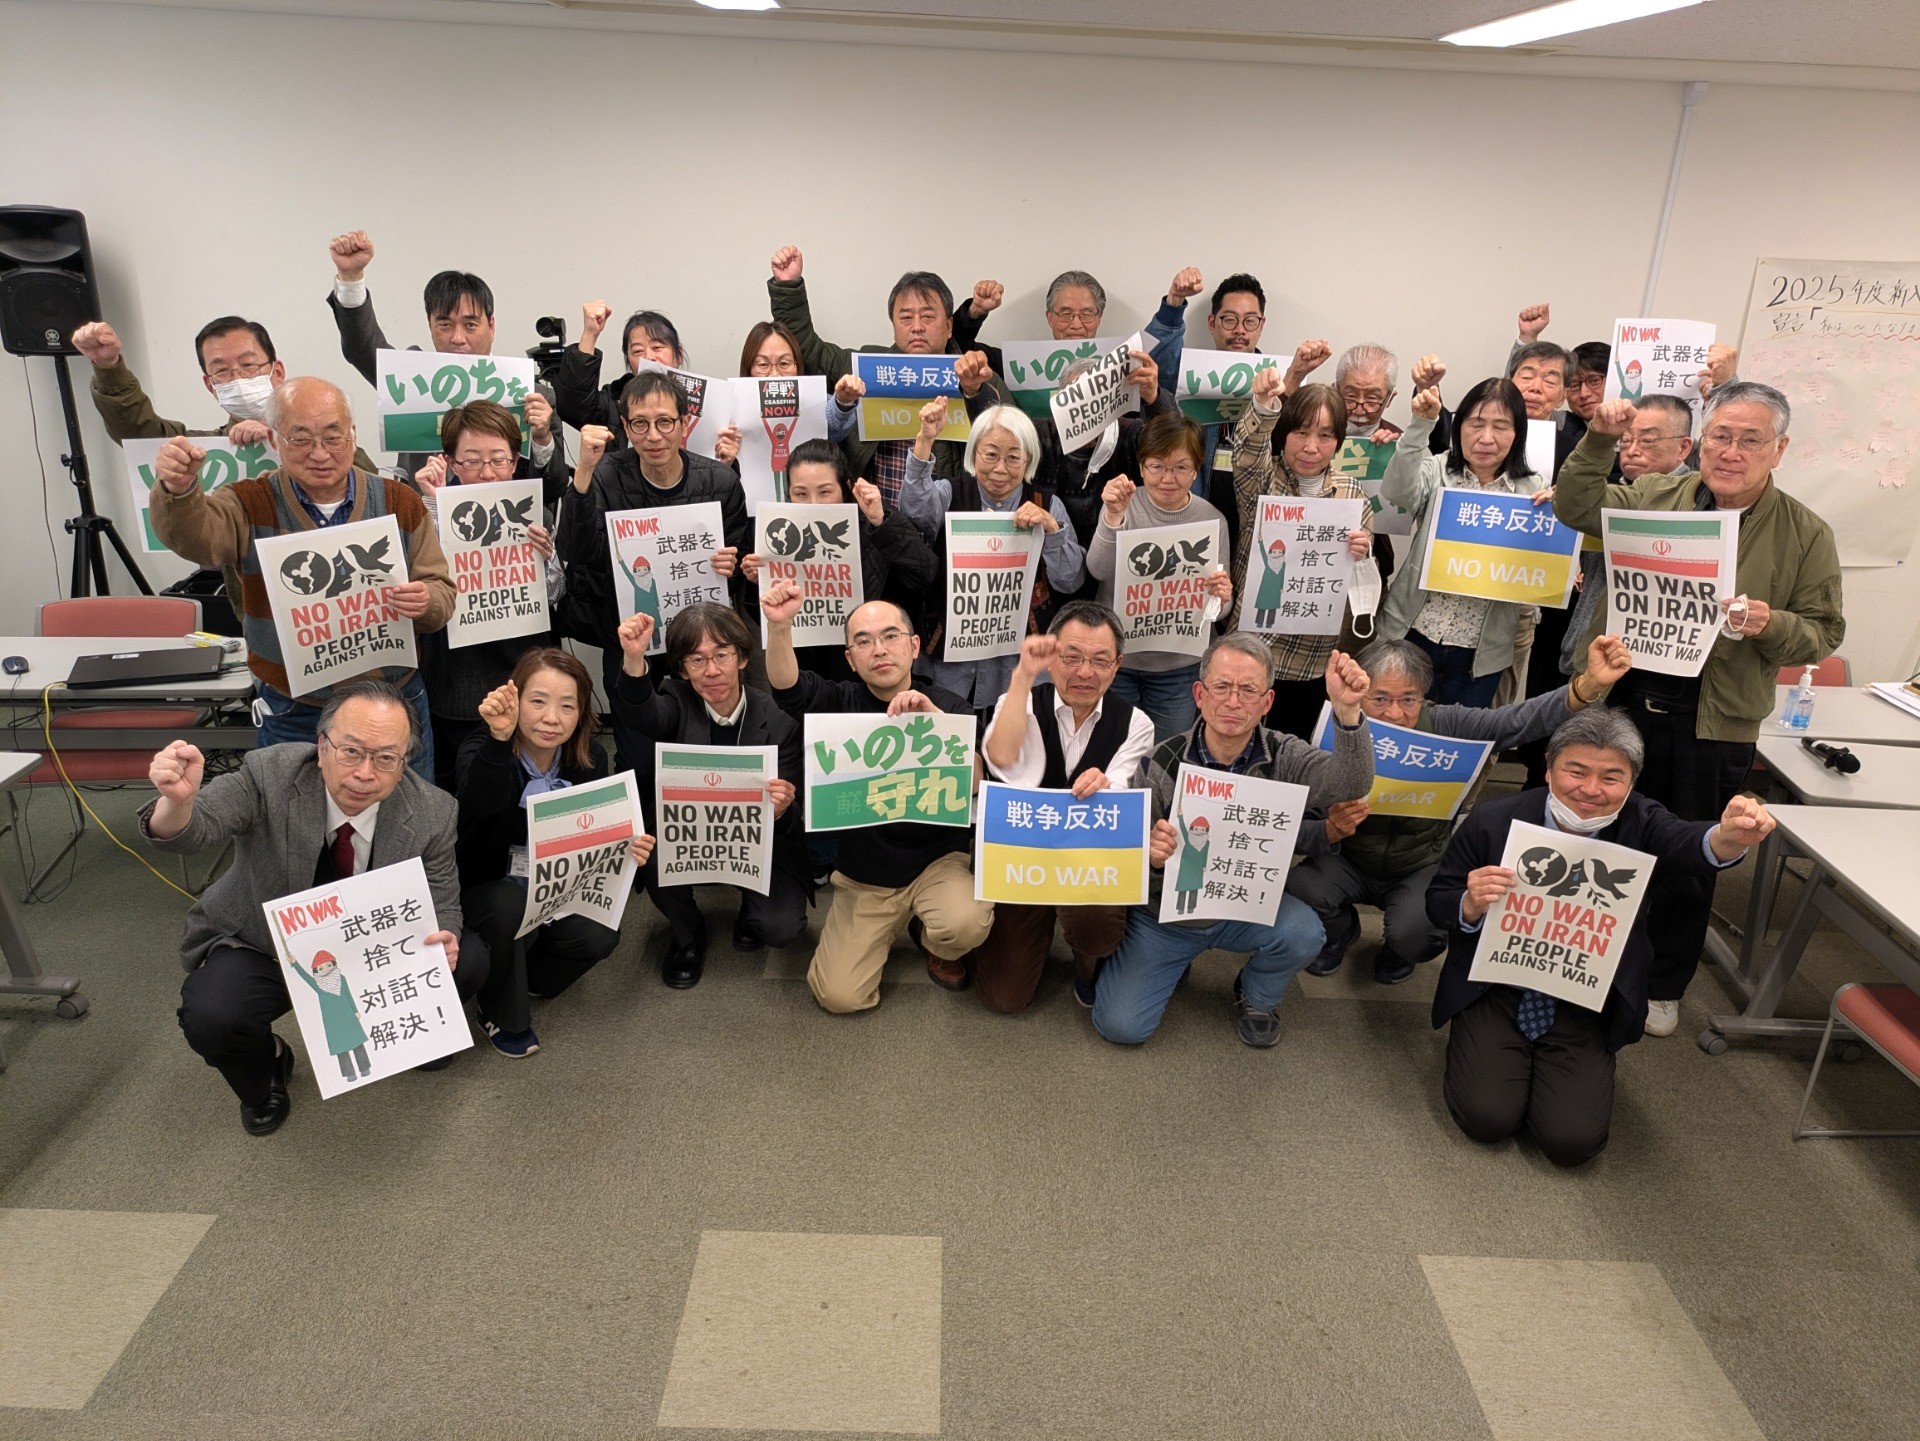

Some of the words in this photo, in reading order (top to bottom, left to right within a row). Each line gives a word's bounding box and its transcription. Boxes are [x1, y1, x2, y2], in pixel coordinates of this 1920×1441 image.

[1622, 326, 1637, 343] NO
[1640, 327, 1660, 342] WAR
[1652, 345, 1708, 364] 武器を
[385, 359, 529, 408] いのちを
[876, 366, 960, 388] 戦争反対
[1056, 384, 1084, 406] ON
[1088, 362, 1130, 397] IRAN
[1658, 370, 1696, 388] 捨て
[762, 381, 795, 398] 停戦
[764, 406, 796, 416] NOW
[1069, 384, 1121, 424] PEOPLE
[881, 410, 912, 426] NO
[1066, 409, 1108, 440] AGAINST
[1110, 393, 1129, 414] WAR
[1264, 504, 1280, 522] NO
[1283, 506, 1305, 522] WAR
[1456, 502, 1558, 536] 戦争反対
[615, 519, 634, 540] NO
[635, 518, 660, 536] WAR
[1296, 524, 1350, 542] 武器を
[656, 532, 716, 555] 武器を
[454, 550, 482, 573] NO
[488, 542, 535, 567] WAR
[1301, 550, 1338, 568] 捨て
[457, 572, 482, 594] ON
[489, 564, 536, 588] IRAN
[670, 560, 708, 580] 捨て
[769, 561, 797, 578] NO
[802, 564, 852, 580] WAR
[1446, 557, 1481, 578] NO
[1490, 562, 1546, 588] WAR
[804, 581, 852, 598] IRAN
[953, 572, 980, 594] NO
[987, 571, 1024, 592] WAR
[1126, 582, 1154, 601] NO
[1160, 578, 1206, 596] WAR
[1286, 576, 1344, 594] 対話で
[1613, 570, 1648, 592] NO
[1654, 575, 1717, 603] WAR
[468, 586, 530, 610] PEOPLE
[662, 586, 722, 608] 対話で
[798, 600, 844, 614] OPLE
[954, 596, 980, 616] ON
[985, 592, 1021, 614] IRAN
[1126, 600, 1150, 616] ON
[1157, 594, 1204, 612] IRAN
[1616, 592, 1648, 615] ON
[1658, 597, 1718, 625] IRAN
[291, 602, 329, 628] NO
[460, 606, 510, 626] AGAINST
[514, 601, 542, 616] WAR
[1134, 611, 1193, 628] PEOPLE
[1281, 601, 1332, 618] 解決！
[298, 623, 332, 647] ON
[339, 606, 400, 635] IRAN
[792, 616, 824, 628] AINST
[828, 616, 848, 626] WA
[961, 616, 1011, 634] PEOPLE
[1124, 625, 1172, 640] AGAINST
[1624, 618, 1702, 646] PEOPLE
[314, 624, 390, 660] PEOPLE
[950, 634, 995, 648] AGAINST
[997, 631, 1016, 644] WAR
[1622, 636, 1672, 658] GAINST
[1675, 646, 1702, 662] WAR
[304, 646, 366, 676] AGAINST
[370, 638, 405, 652] WAR
[814, 716, 969, 776] いのちを
[1371, 734, 1459, 770] 争反対
[866, 769, 967, 820] 守れ
[1186, 774, 1205, 794] NO
[1208, 780, 1234, 800] WAR
[1379, 791, 1437, 804] WAR
[664, 804, 697, 823] NO
[704, 806, 762, 824] WAR
[1006, 800, 1120, 830] 戦争反対
[1222, 804, 1291, 831] 武器を
[664, 824, 697, 842] ON
[706, 825, 762, 845] IRAN
[1228, 831, 1274, 853] 捨て
[536, 857, 570, 884] NO
[578, 840, 630, 872] WAR
[676, 845, 750, 861] PEOPLE
[534, 879, 566, 903] ON
[572, 858, 624, 888] IRAN
[664, 860, 726, 874] AGAINST
[730, 861, 760, 878] WAR
[1006, 863, 1046, 886] NO
[1054, 866, 1119, 886] WAR
[1210, 856, 1280, 882] 対話で
[540, 876, 606, 914] PEOPLE
[582, 891, 613, 911] WAR
[1203, 880, 1266, 904] 解決！
[278, 906, 307, 935] NO
[306, 896, 343, 925] WAR
[340, 898, 422, 943] 武器を
[1504, 892, 1544, 916] NO
[1554, 900, 1617, 937] WAR
[1500, 914, 1536, 936] ON
[1542, 921, 1610, 958] IRAN
[363, 935, 416, 972] 捨て
[1506, 935, 1590, 970] PEOPLE
[1489, 950, 1558, 974] AGAINST
[1562, 968, 1599, 988] WAR
[360, 966, 442, 1014] 対話で
[370, 1006, 446, 1050] 解決！
